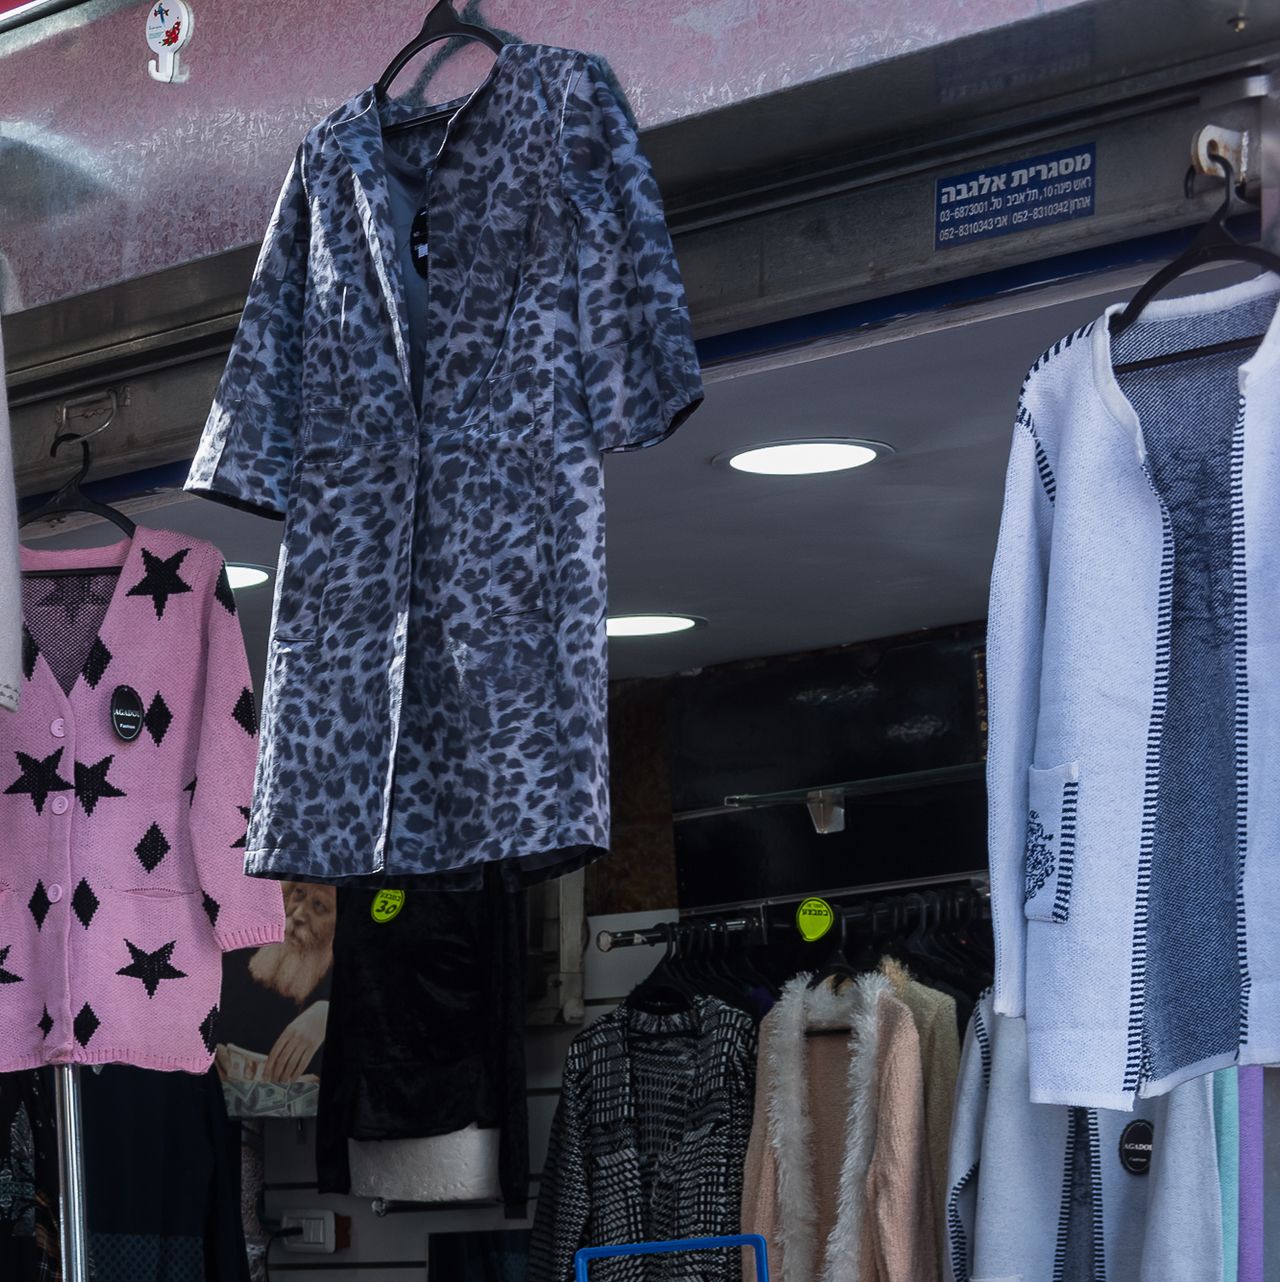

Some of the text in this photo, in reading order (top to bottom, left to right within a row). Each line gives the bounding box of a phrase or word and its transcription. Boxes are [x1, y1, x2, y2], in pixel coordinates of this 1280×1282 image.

[941, 152, 1092, 204] מסגרית אלגבה
[1073, 176, 1092, 191] ראש
[375, 900, 397, 914] 30
